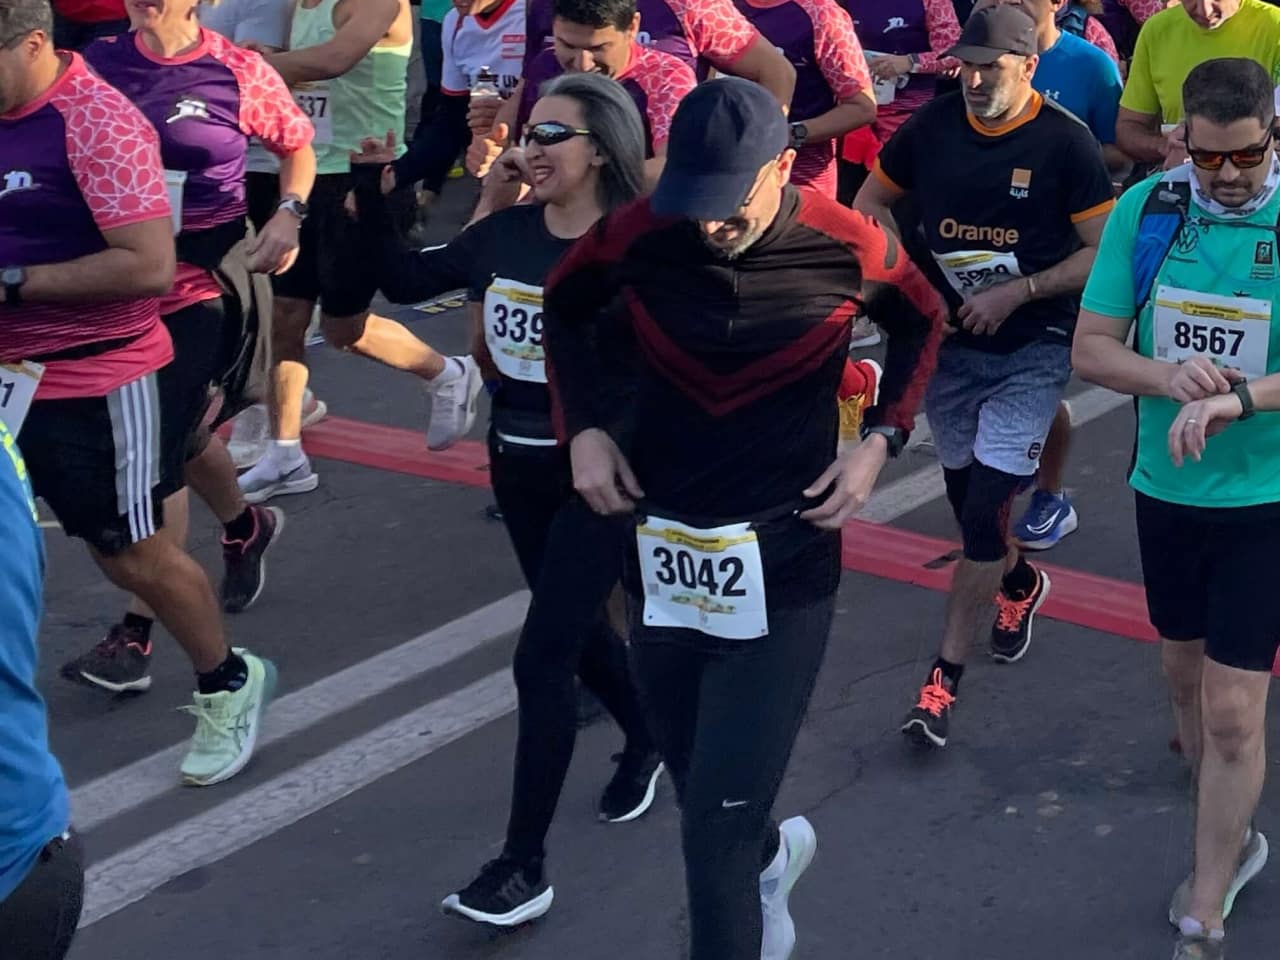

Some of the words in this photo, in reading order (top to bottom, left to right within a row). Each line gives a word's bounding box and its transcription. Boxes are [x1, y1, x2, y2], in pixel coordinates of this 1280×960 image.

[939, 219, 1020, 247] Orange
[1174, 321, 1245, 357] 8567
[652, 546, 746, 598] 3042
